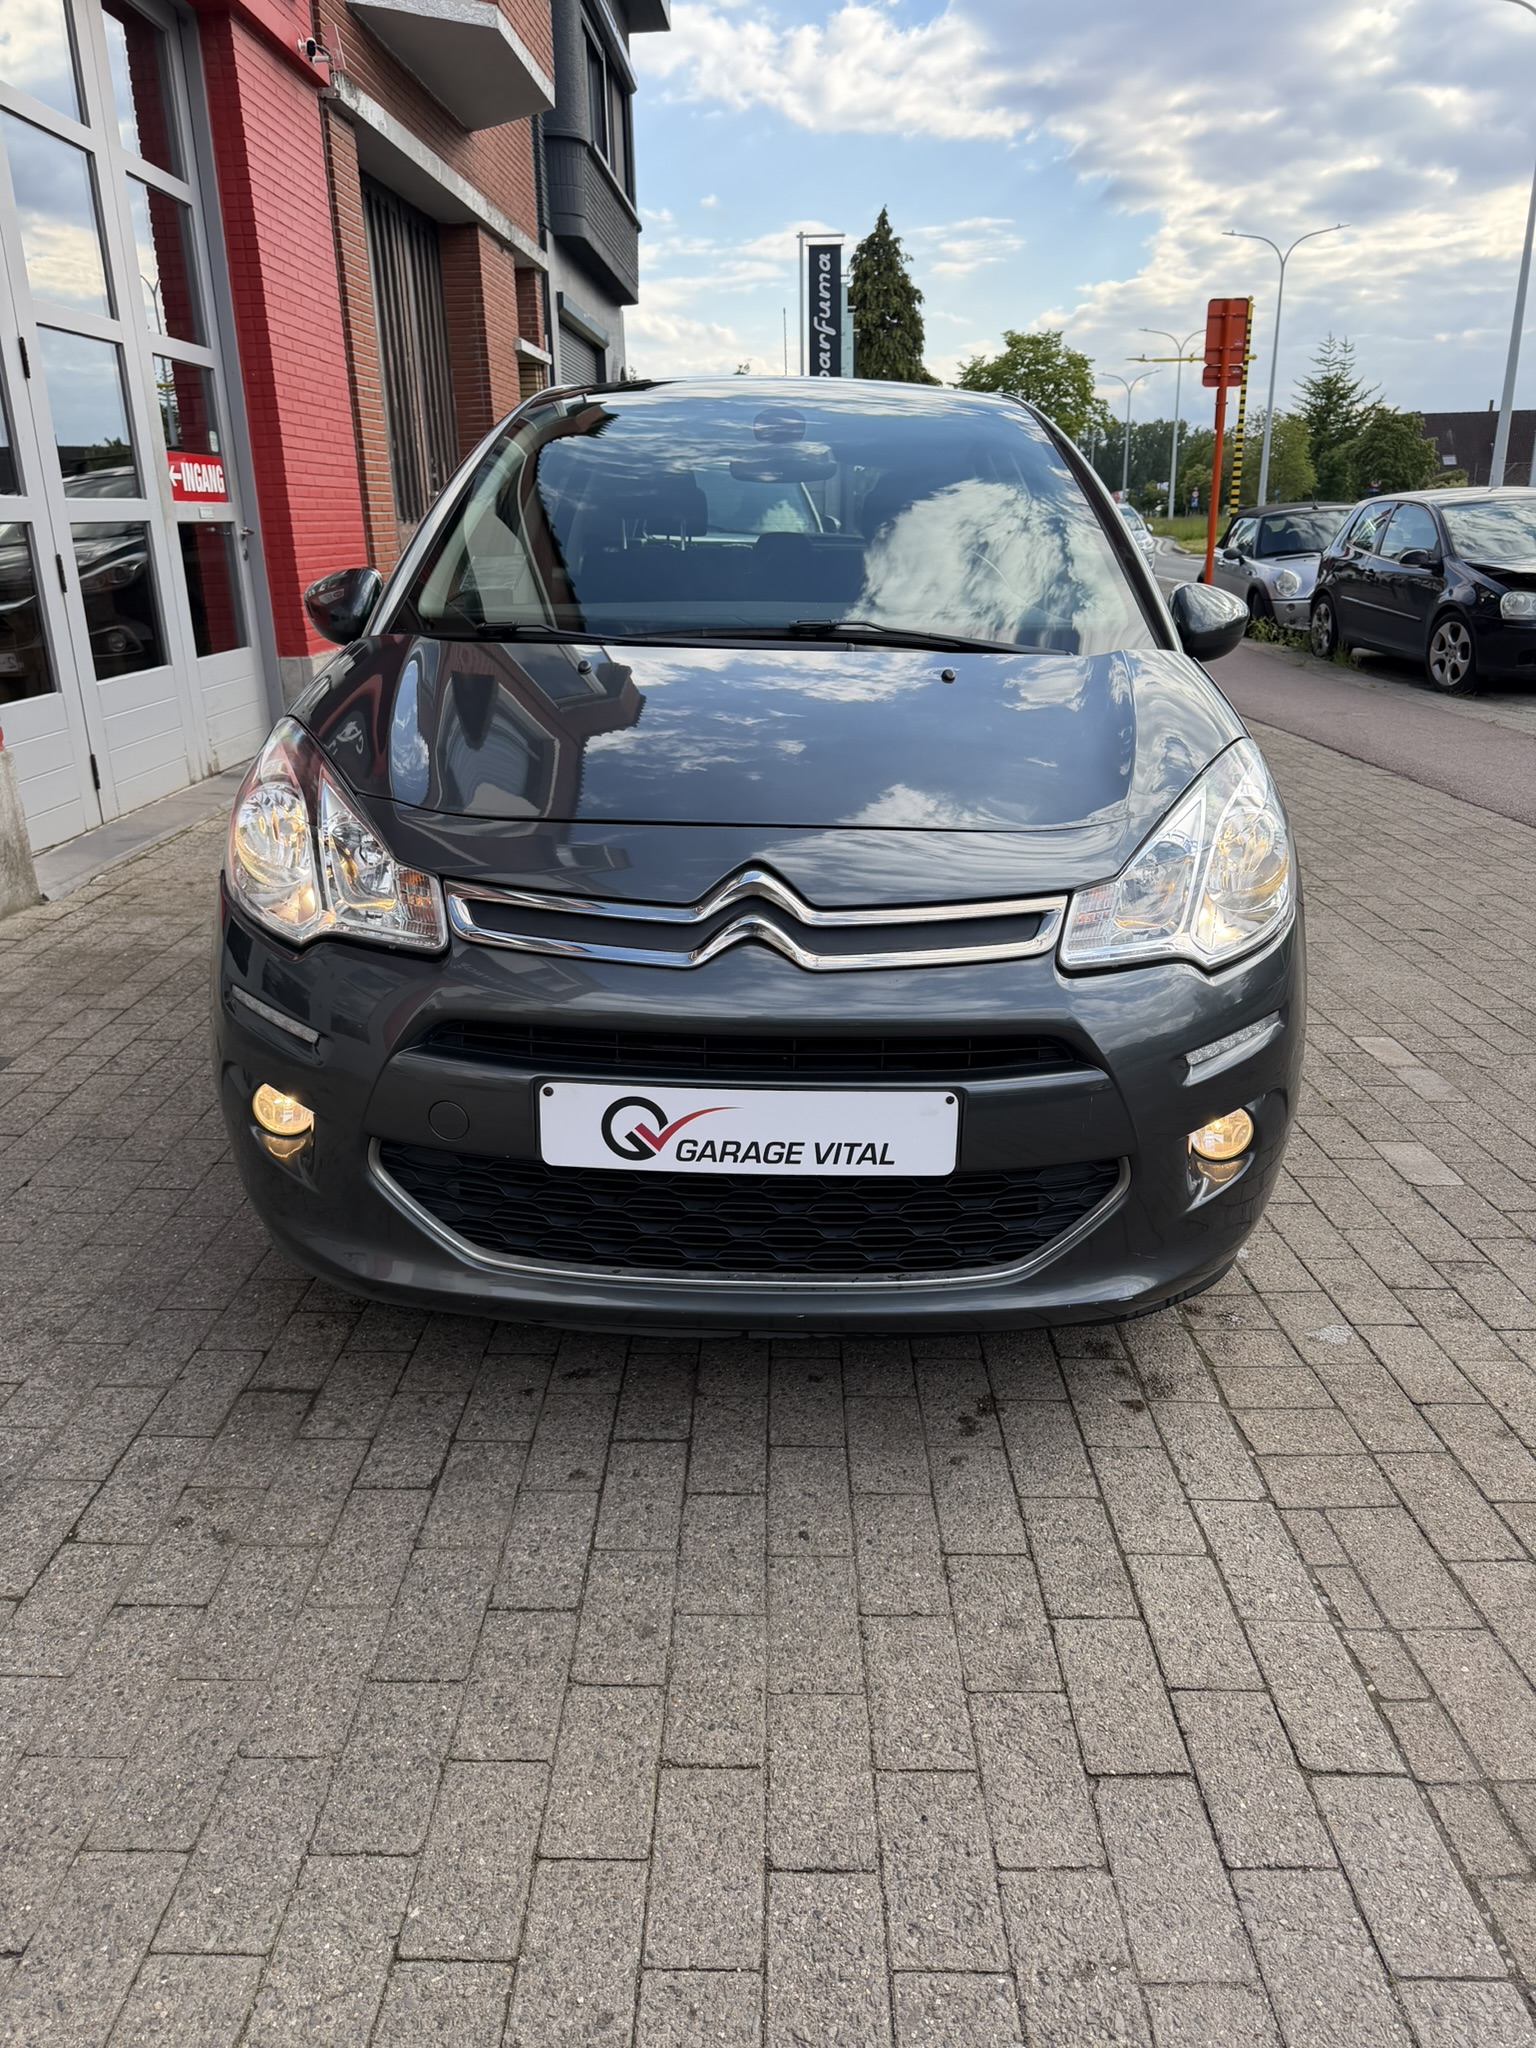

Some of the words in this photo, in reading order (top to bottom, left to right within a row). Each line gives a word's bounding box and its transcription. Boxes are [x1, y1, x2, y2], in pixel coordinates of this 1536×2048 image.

[180, 462, 226, 493] INGANG
[675, 1139, 806, 1165] GARAGE
[814, 1142, 896, 1165] VITAL
